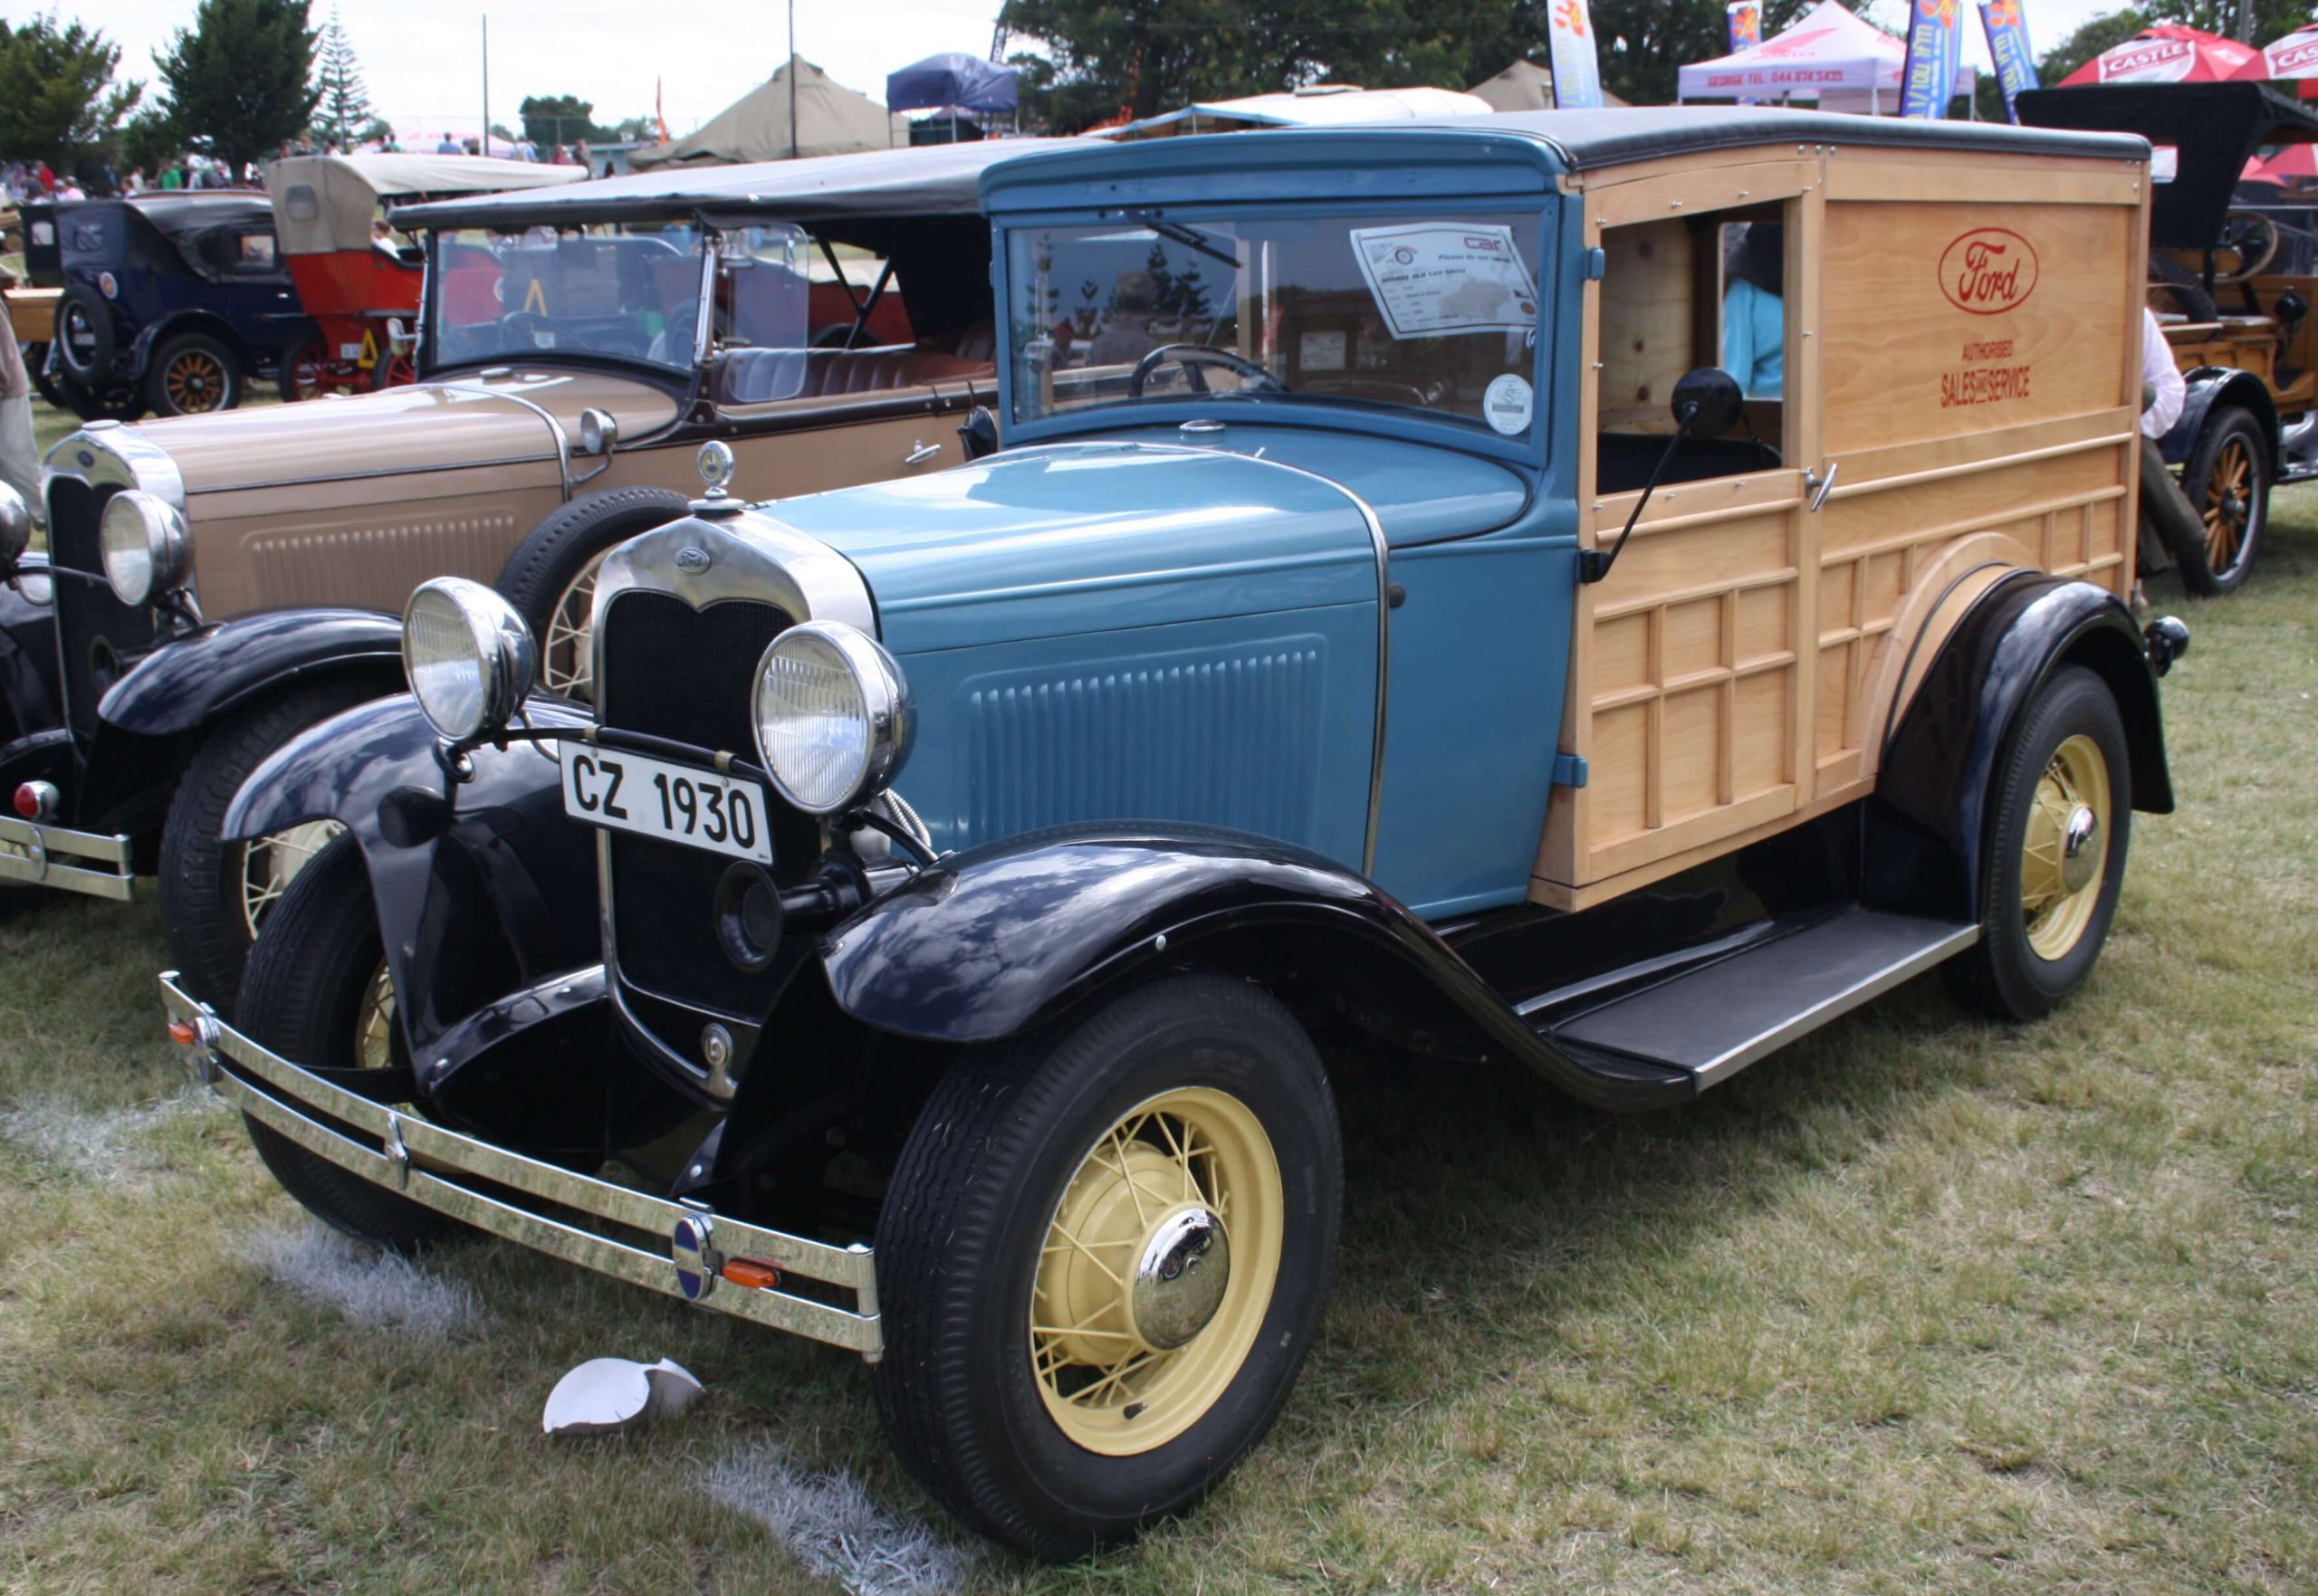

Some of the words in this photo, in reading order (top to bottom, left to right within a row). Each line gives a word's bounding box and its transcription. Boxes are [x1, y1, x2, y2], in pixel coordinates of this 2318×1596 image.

[2109, 45, 2183, 72] CASTLE
[1708, 74, 1743, 87] GEORGE
[1771, 72, 1792, 83] 044
[1464, 236, 1501, 251] car
[1959, 241, 2020, 301] Ford
[1962, 339, 2014, 362] AUTHORISED
[1940, 370, 1976, 408] SALES
[1988, 366, 2030, 401] SERVICE
[572, 754, 627, 820] CZ
[654, 772, 755, 848] 1930
